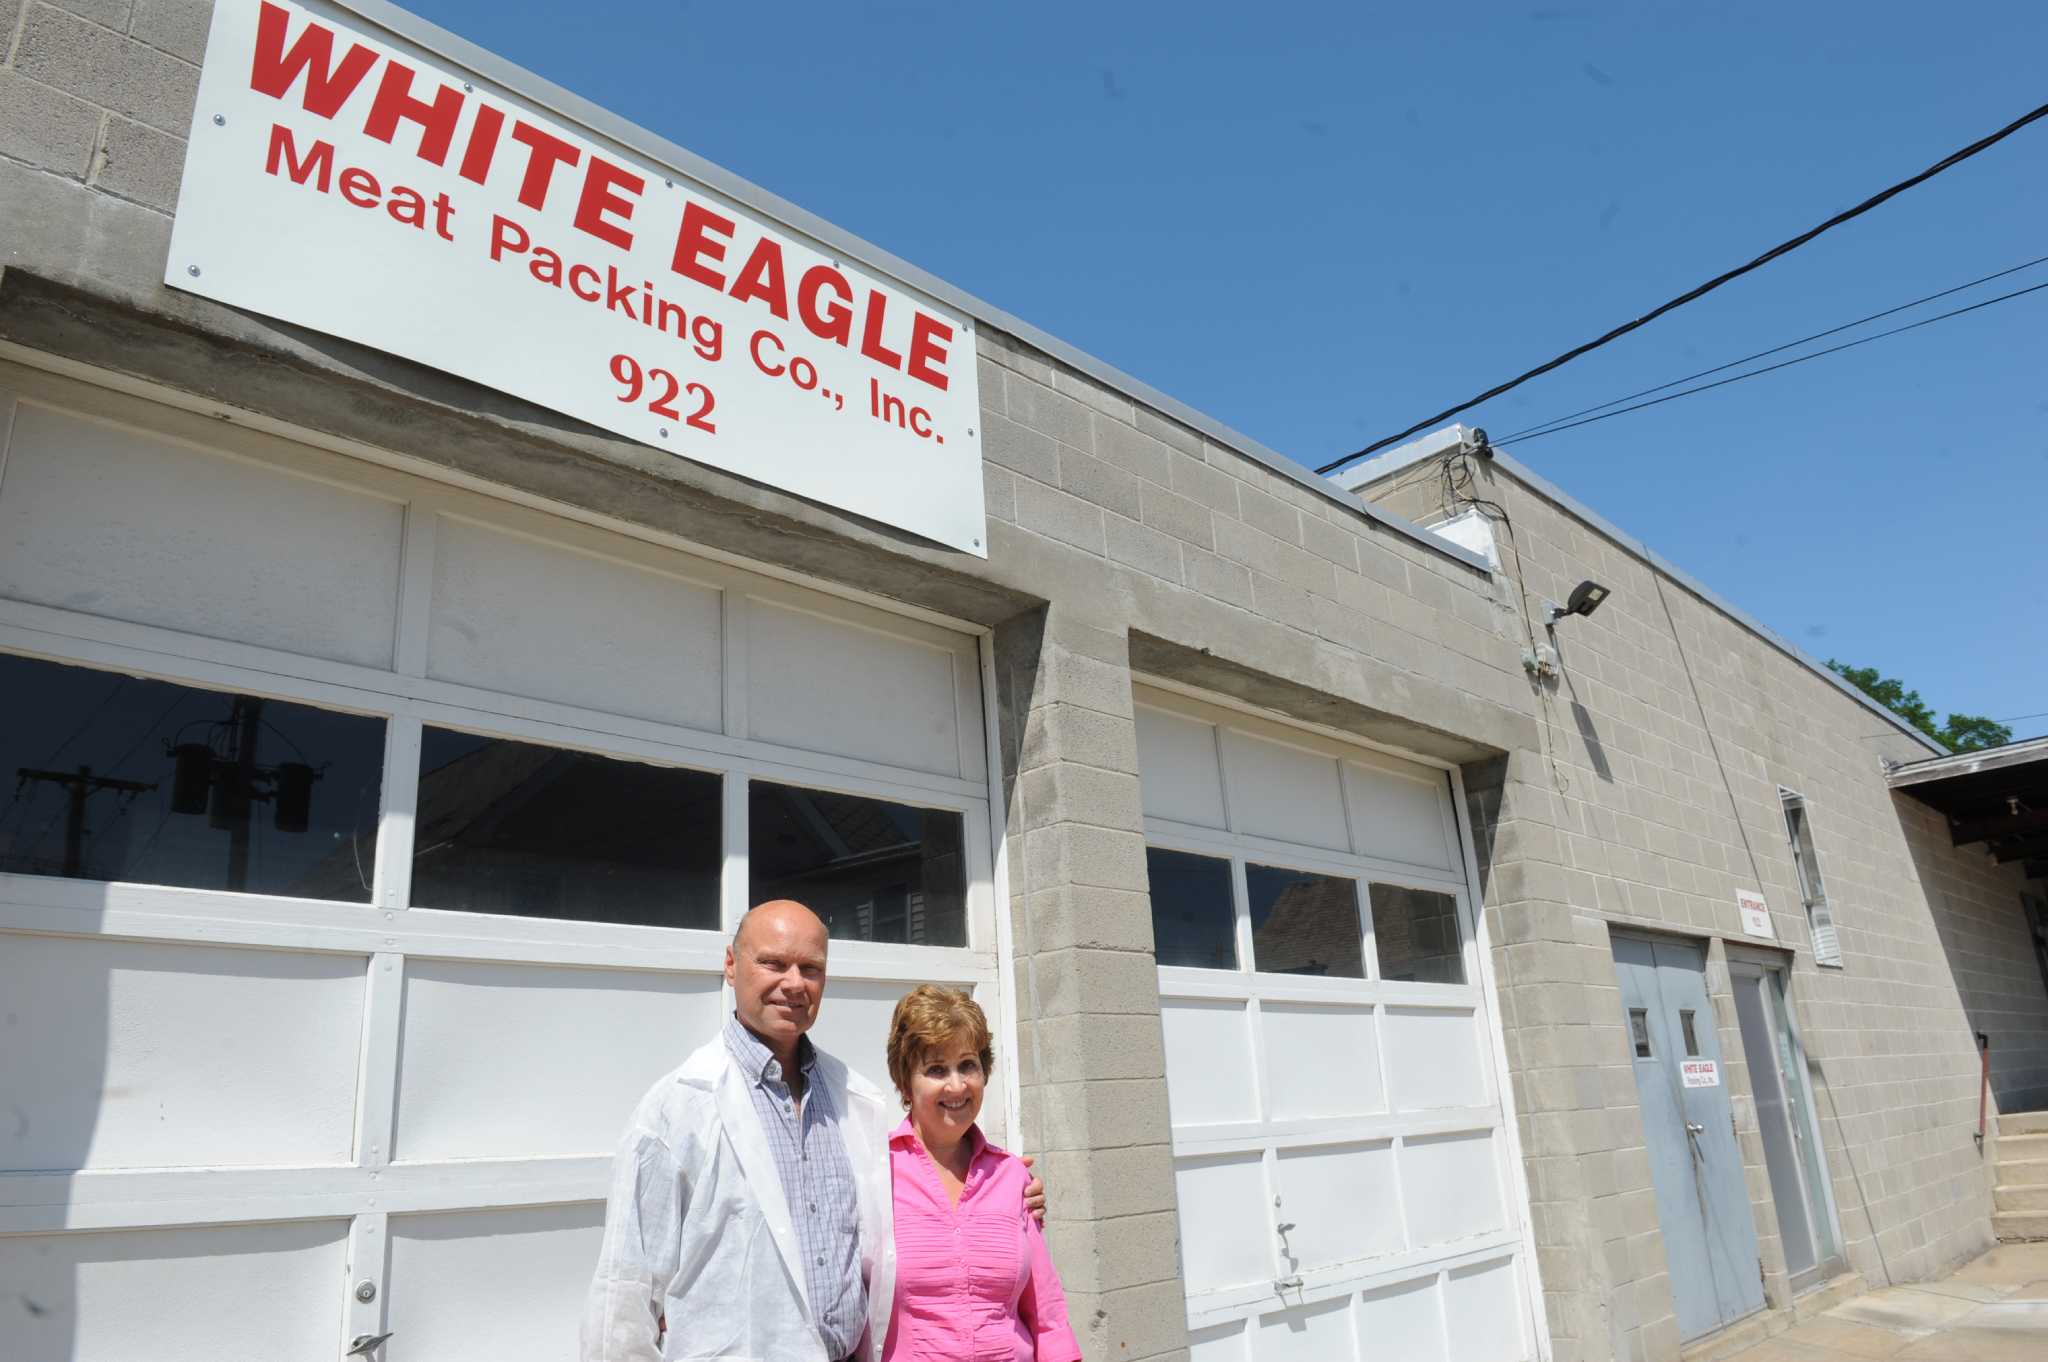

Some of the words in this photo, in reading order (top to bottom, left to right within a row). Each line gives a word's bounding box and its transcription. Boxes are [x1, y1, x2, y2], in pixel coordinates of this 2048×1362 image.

[251, 0, 645, 250] WHITE
[672, 203, 953, 390] EAGLE
[266, 124, 456, 241] Meat
[491, 216, 724, 362] Packing
[751, 330, 844, 409] Co.,
[871, 378, 945, 444] Inc.
[611, 354, 717, 434] 922
